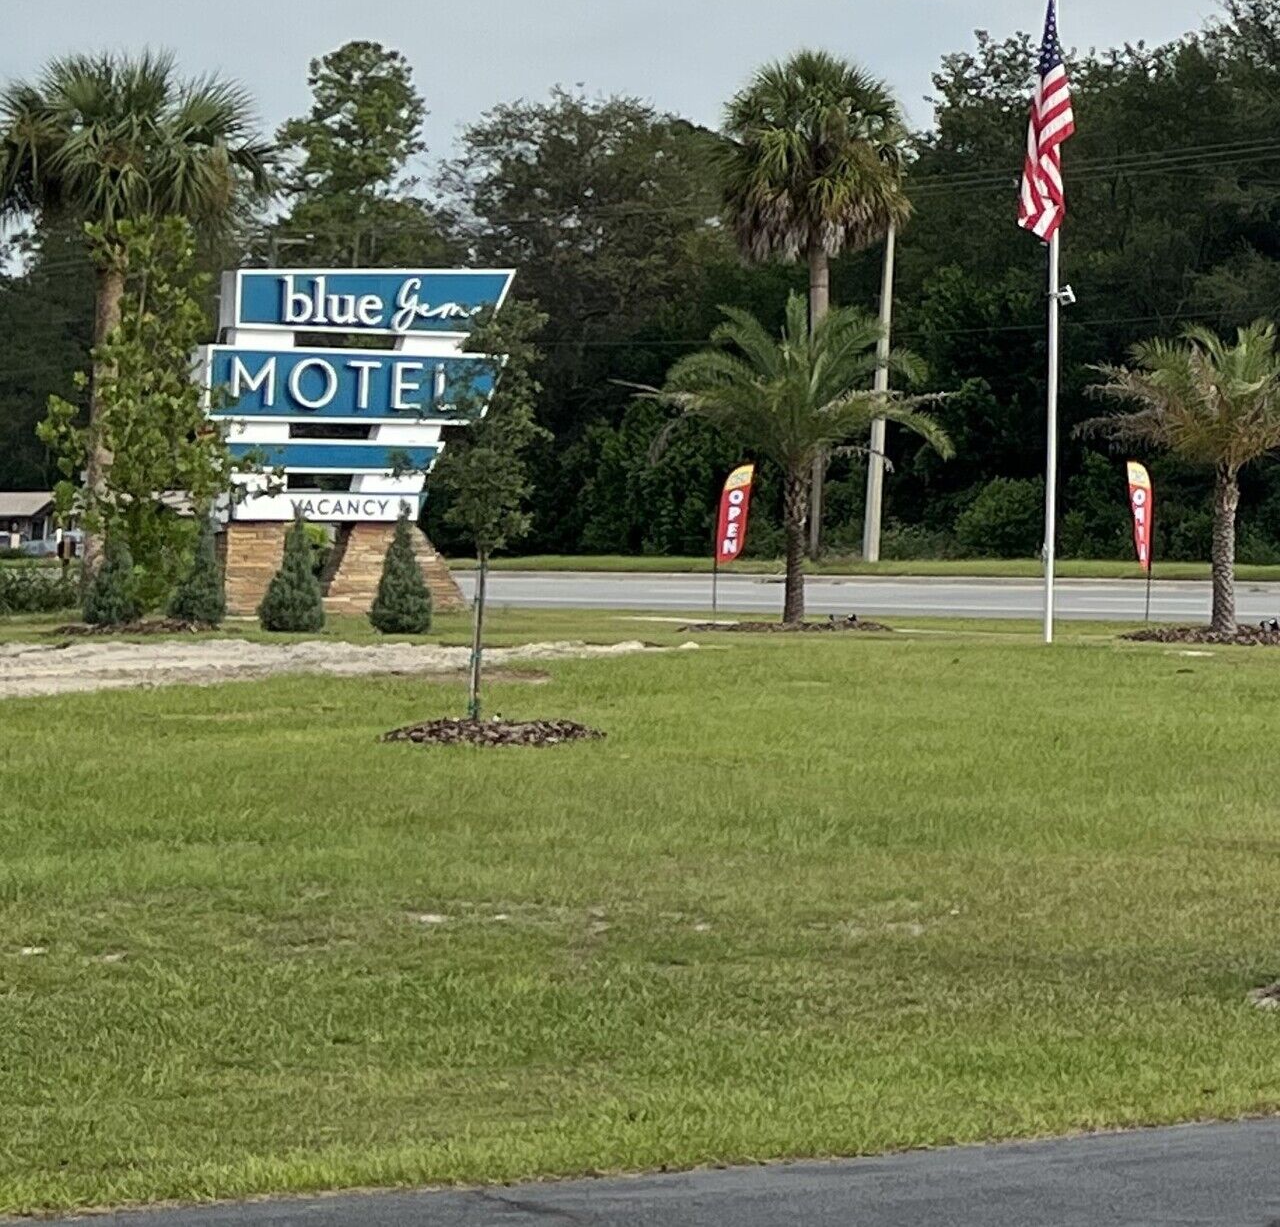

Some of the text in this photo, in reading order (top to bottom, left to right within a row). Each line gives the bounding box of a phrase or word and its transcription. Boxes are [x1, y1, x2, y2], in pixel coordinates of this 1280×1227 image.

[282, 275, 482, 331] blue Gem
[230, 356, 457, 411] MOTEL
[290, 499, 388, 516] VACANCY
[723, 489, 744, 554] OPEN
